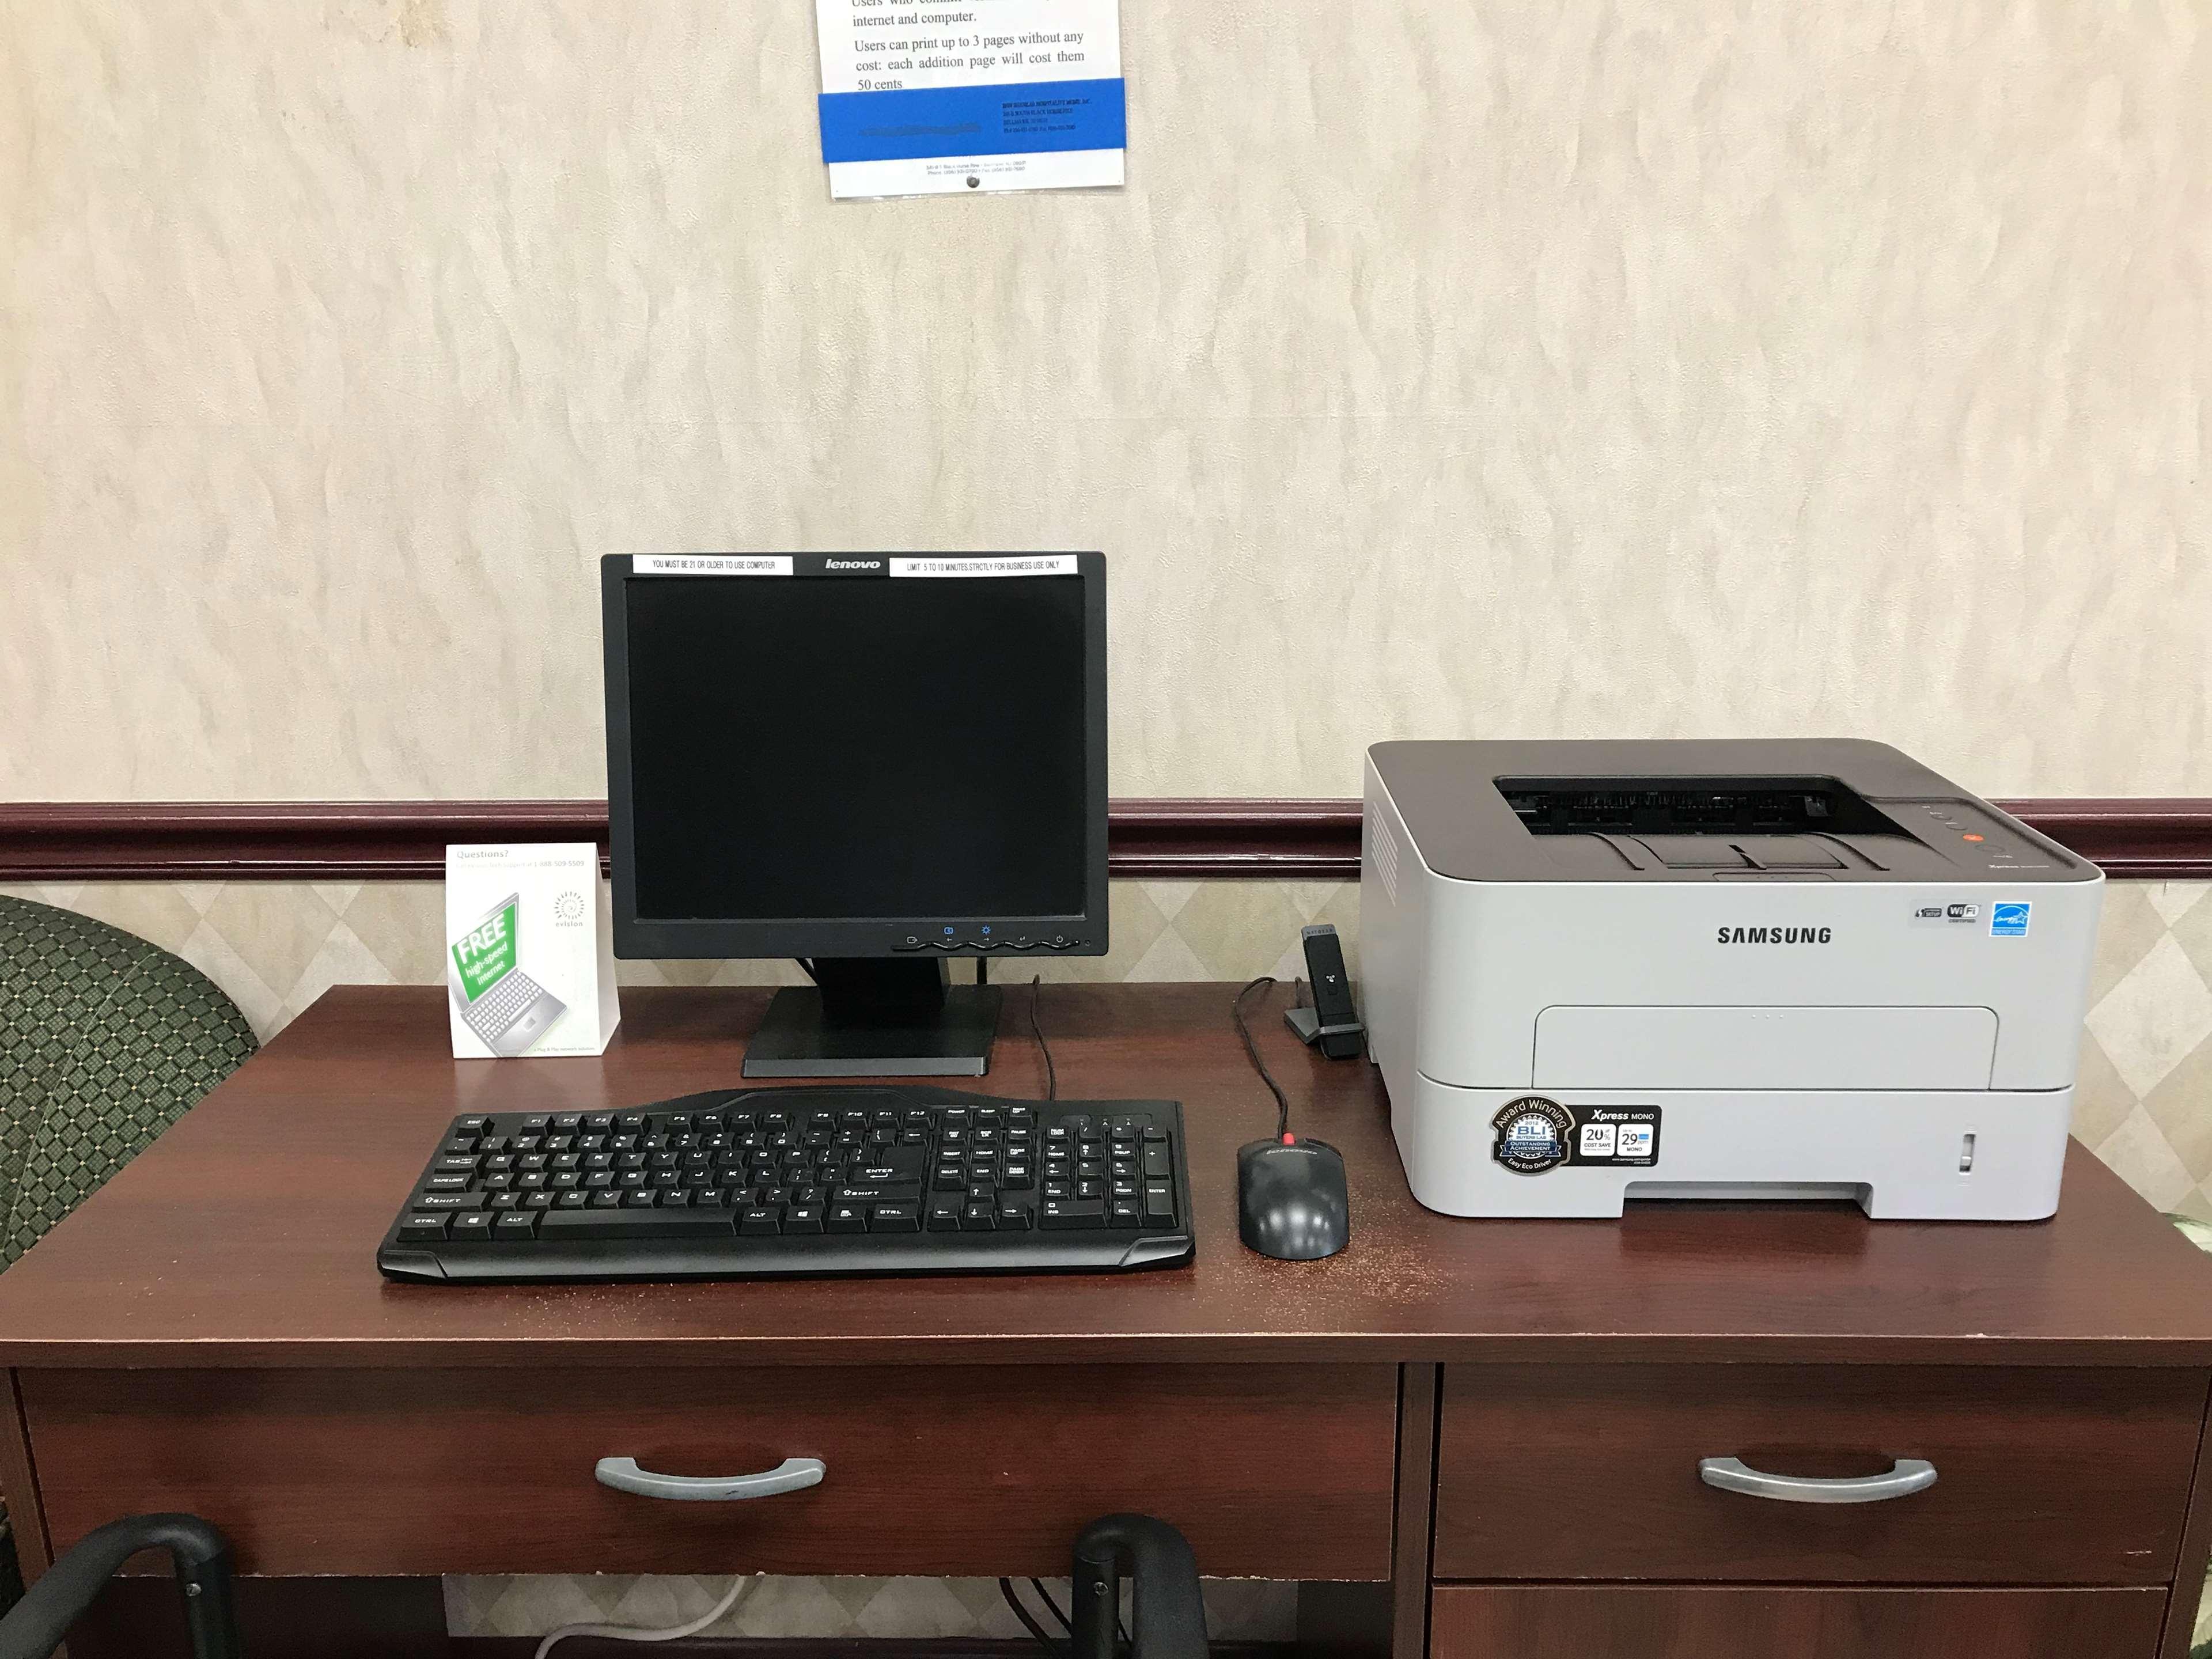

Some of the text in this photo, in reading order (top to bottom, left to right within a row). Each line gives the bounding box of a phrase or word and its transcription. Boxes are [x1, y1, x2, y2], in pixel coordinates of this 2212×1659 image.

[853, 12, 976, 26] internet and computer.
[855, 32, 1084, 52] Users can print up to 3 pages without any
[856, 51, 1084, 71] cost: each addition page will cost them
[858, 79, 903, 90] 50 cents
[825, 559, 881, 569] lenovo
[1006, 562, 1032, 570] BUSINESS
[1033, 561, 1044, 569] USE
[1046, 560, 1059, 569] ONLY
[457, 850, 509, 859] Questions?
[457, 913, 506, 964] FREE
[1718, 927, 1831, 944] SAMSUNG
[465, 941, 507, 978] high-speed
[1496, 1100, 1566, 1128] Award Winning
[1591, 1109, 1629, 1122] Xpress
[1517, 1126, 1546, 1135] BLI
[1622, 1134, 1638, 1145] 29
[1508, 1158, 1521, 1168] Easy
[1534, 1159, 1552, 1168] Driver
